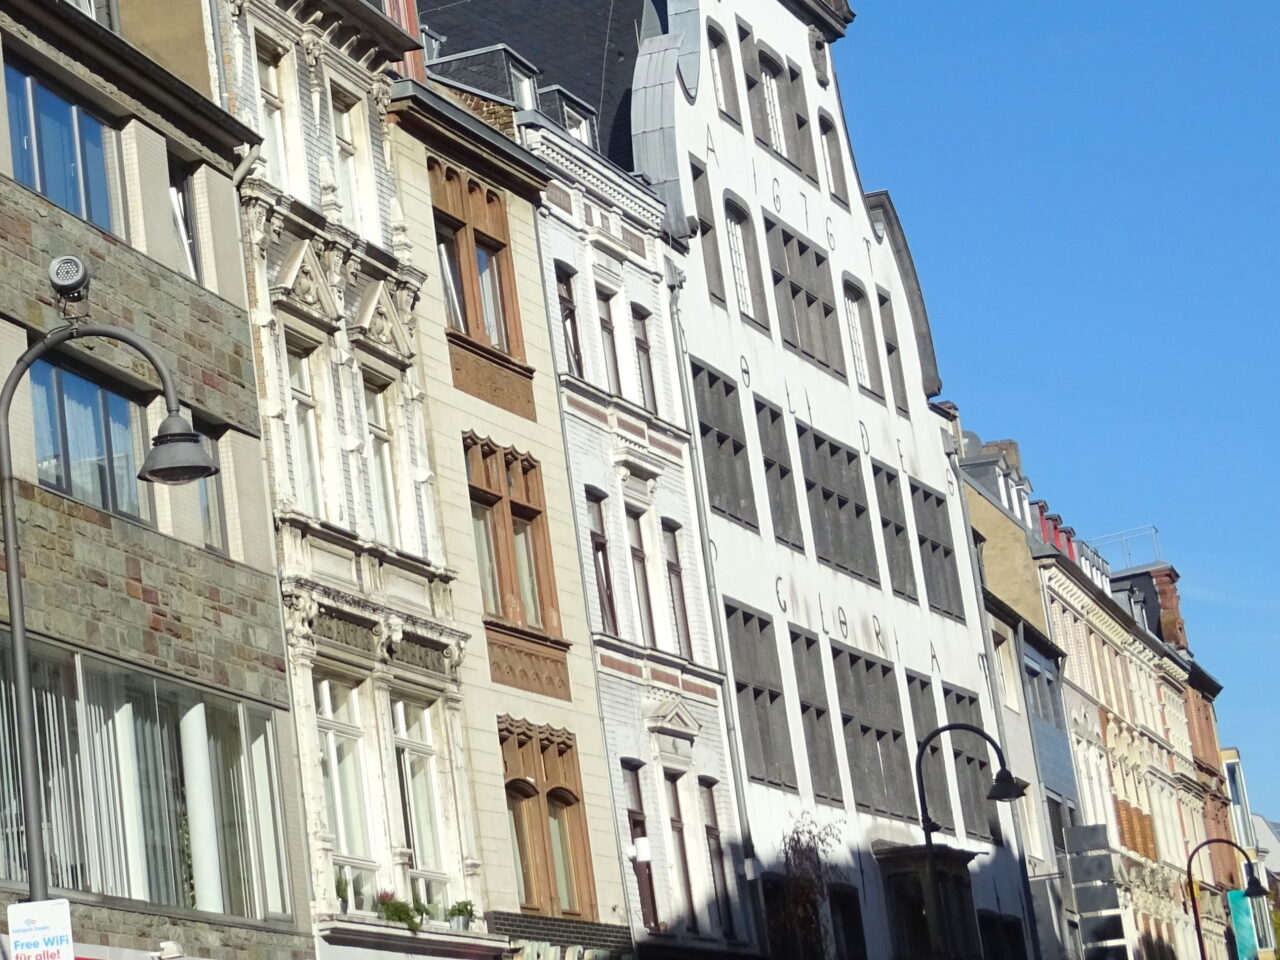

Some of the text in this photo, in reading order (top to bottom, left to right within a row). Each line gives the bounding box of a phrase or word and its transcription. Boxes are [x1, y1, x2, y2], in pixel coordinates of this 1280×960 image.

[14, 935, 69, 950] Free WiFi
[35, 949, 60, 960] alle!
